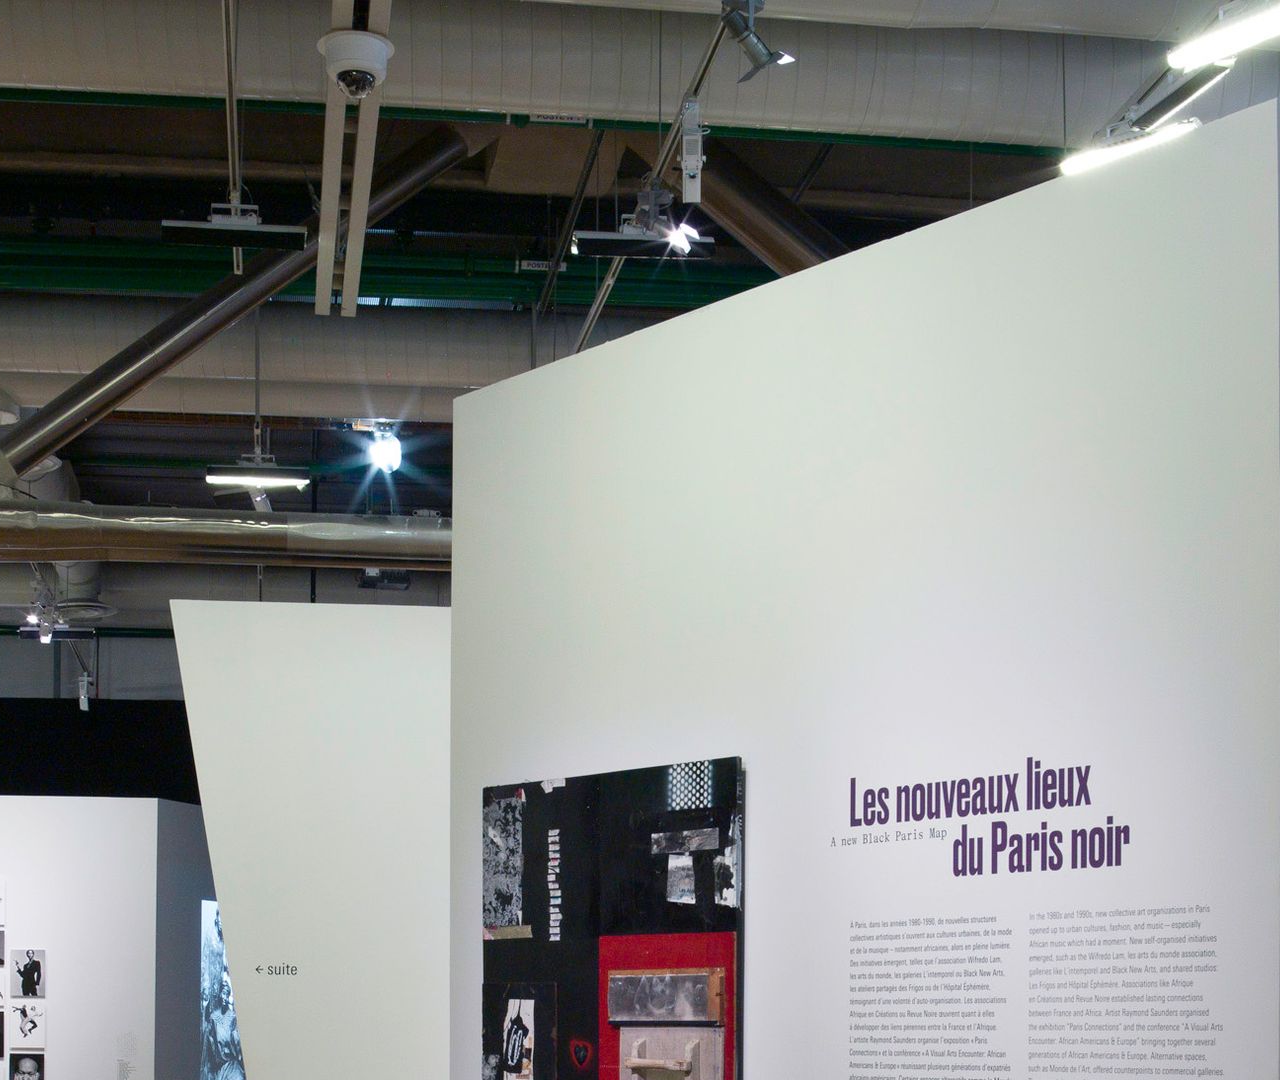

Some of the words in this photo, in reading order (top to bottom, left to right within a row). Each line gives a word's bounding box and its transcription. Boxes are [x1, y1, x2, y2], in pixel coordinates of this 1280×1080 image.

[850, 777, 890, 827] Les
[896, 772, 1019, 824] nouveaux
[1026, 757, 1092, 810] lieux
[830, 836, 836, 848] A
[841, 836, 858, 846] new
[862, 832, 890, 844] Black
[896, 830, 924, 842] Paris
[929, 827, 948, 840] Map
[952, 824, 983, 877] du
[991, 821, 1063, 875] Paris
[1071, 816, 1130, 870] noir
[1195, 904, 1210, 913] Paris
[970, 915, 997, 924] structures
[997, 927, 1012, 936] mode
[268, 962, 298, 976] suite
[1150, 1009, 1178, 1017] Saunders
[1210, 1023, 1224, 1031] Arts
